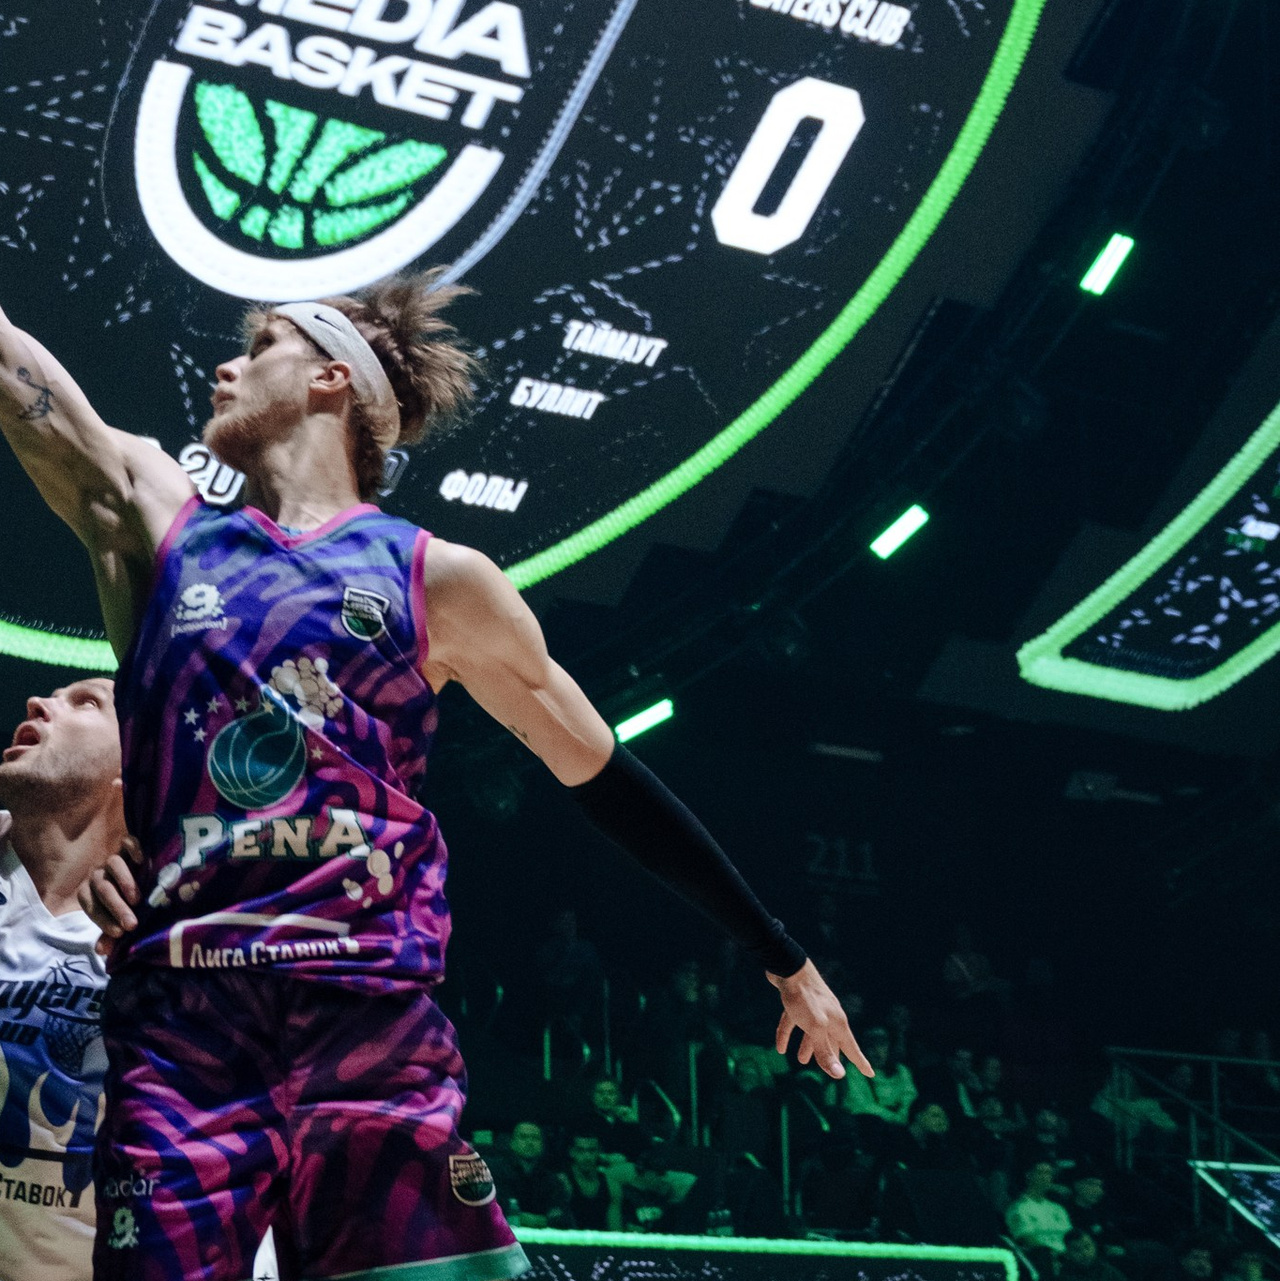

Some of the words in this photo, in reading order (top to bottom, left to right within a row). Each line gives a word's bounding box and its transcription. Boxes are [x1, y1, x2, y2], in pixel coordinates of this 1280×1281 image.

[175, 5, 524, 130] BASKET
[711, 76, 866, 256] 0
[439, 469, 528, 513] ФОЛЫ
[180, 807, 371, 869] PENA
